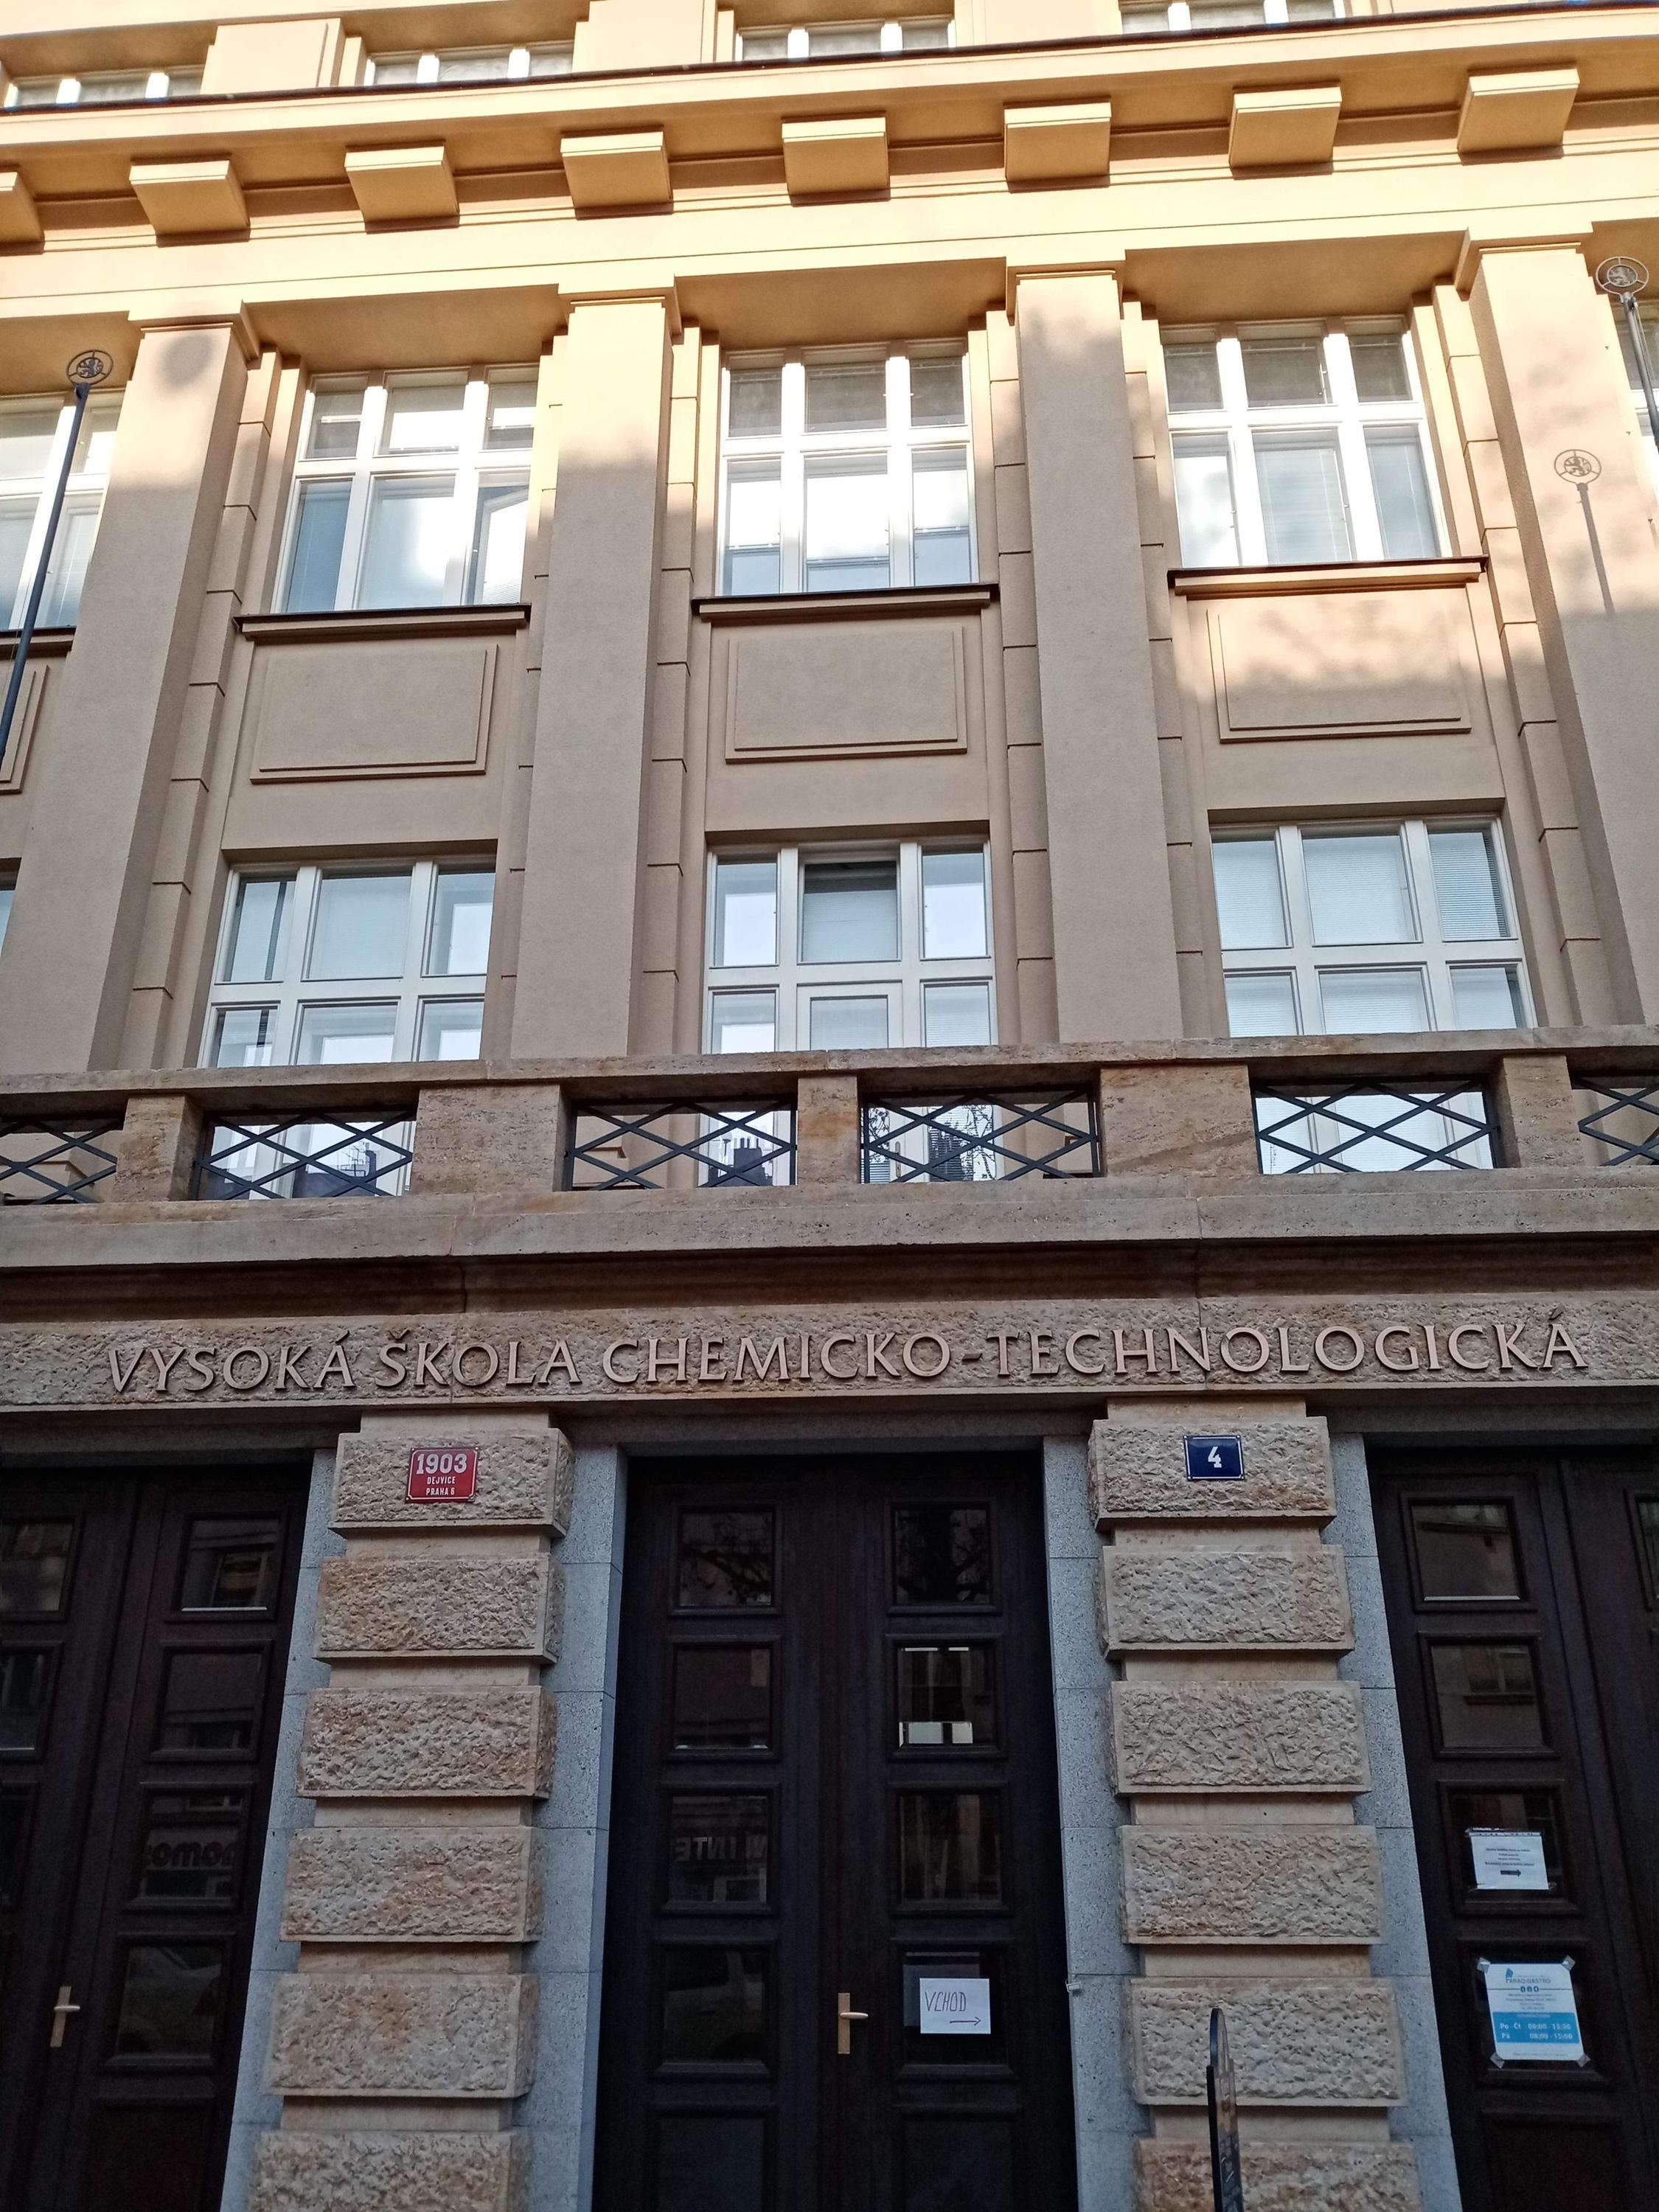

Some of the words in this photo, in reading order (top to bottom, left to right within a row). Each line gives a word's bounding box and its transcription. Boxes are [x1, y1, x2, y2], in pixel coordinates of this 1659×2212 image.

[108, 1330, 357, 1393] VYSOKÁ
[375, 1329, 582, 1387] ŠKOLA
[602, 1305, 1589, 1382] CHEMICKO-TECHNOLOGICKÁ
[416, 1453, 467, 1475] 1903
[1208, 1446, 1222, 1468] 4
[427, 1476, 456, 1484] DEJVICE
[425, 1487, 449, 1496] PRAHA
[451, 1487, 455, 1495] 6
[925, 1992, 967, 2011] VCHOD
